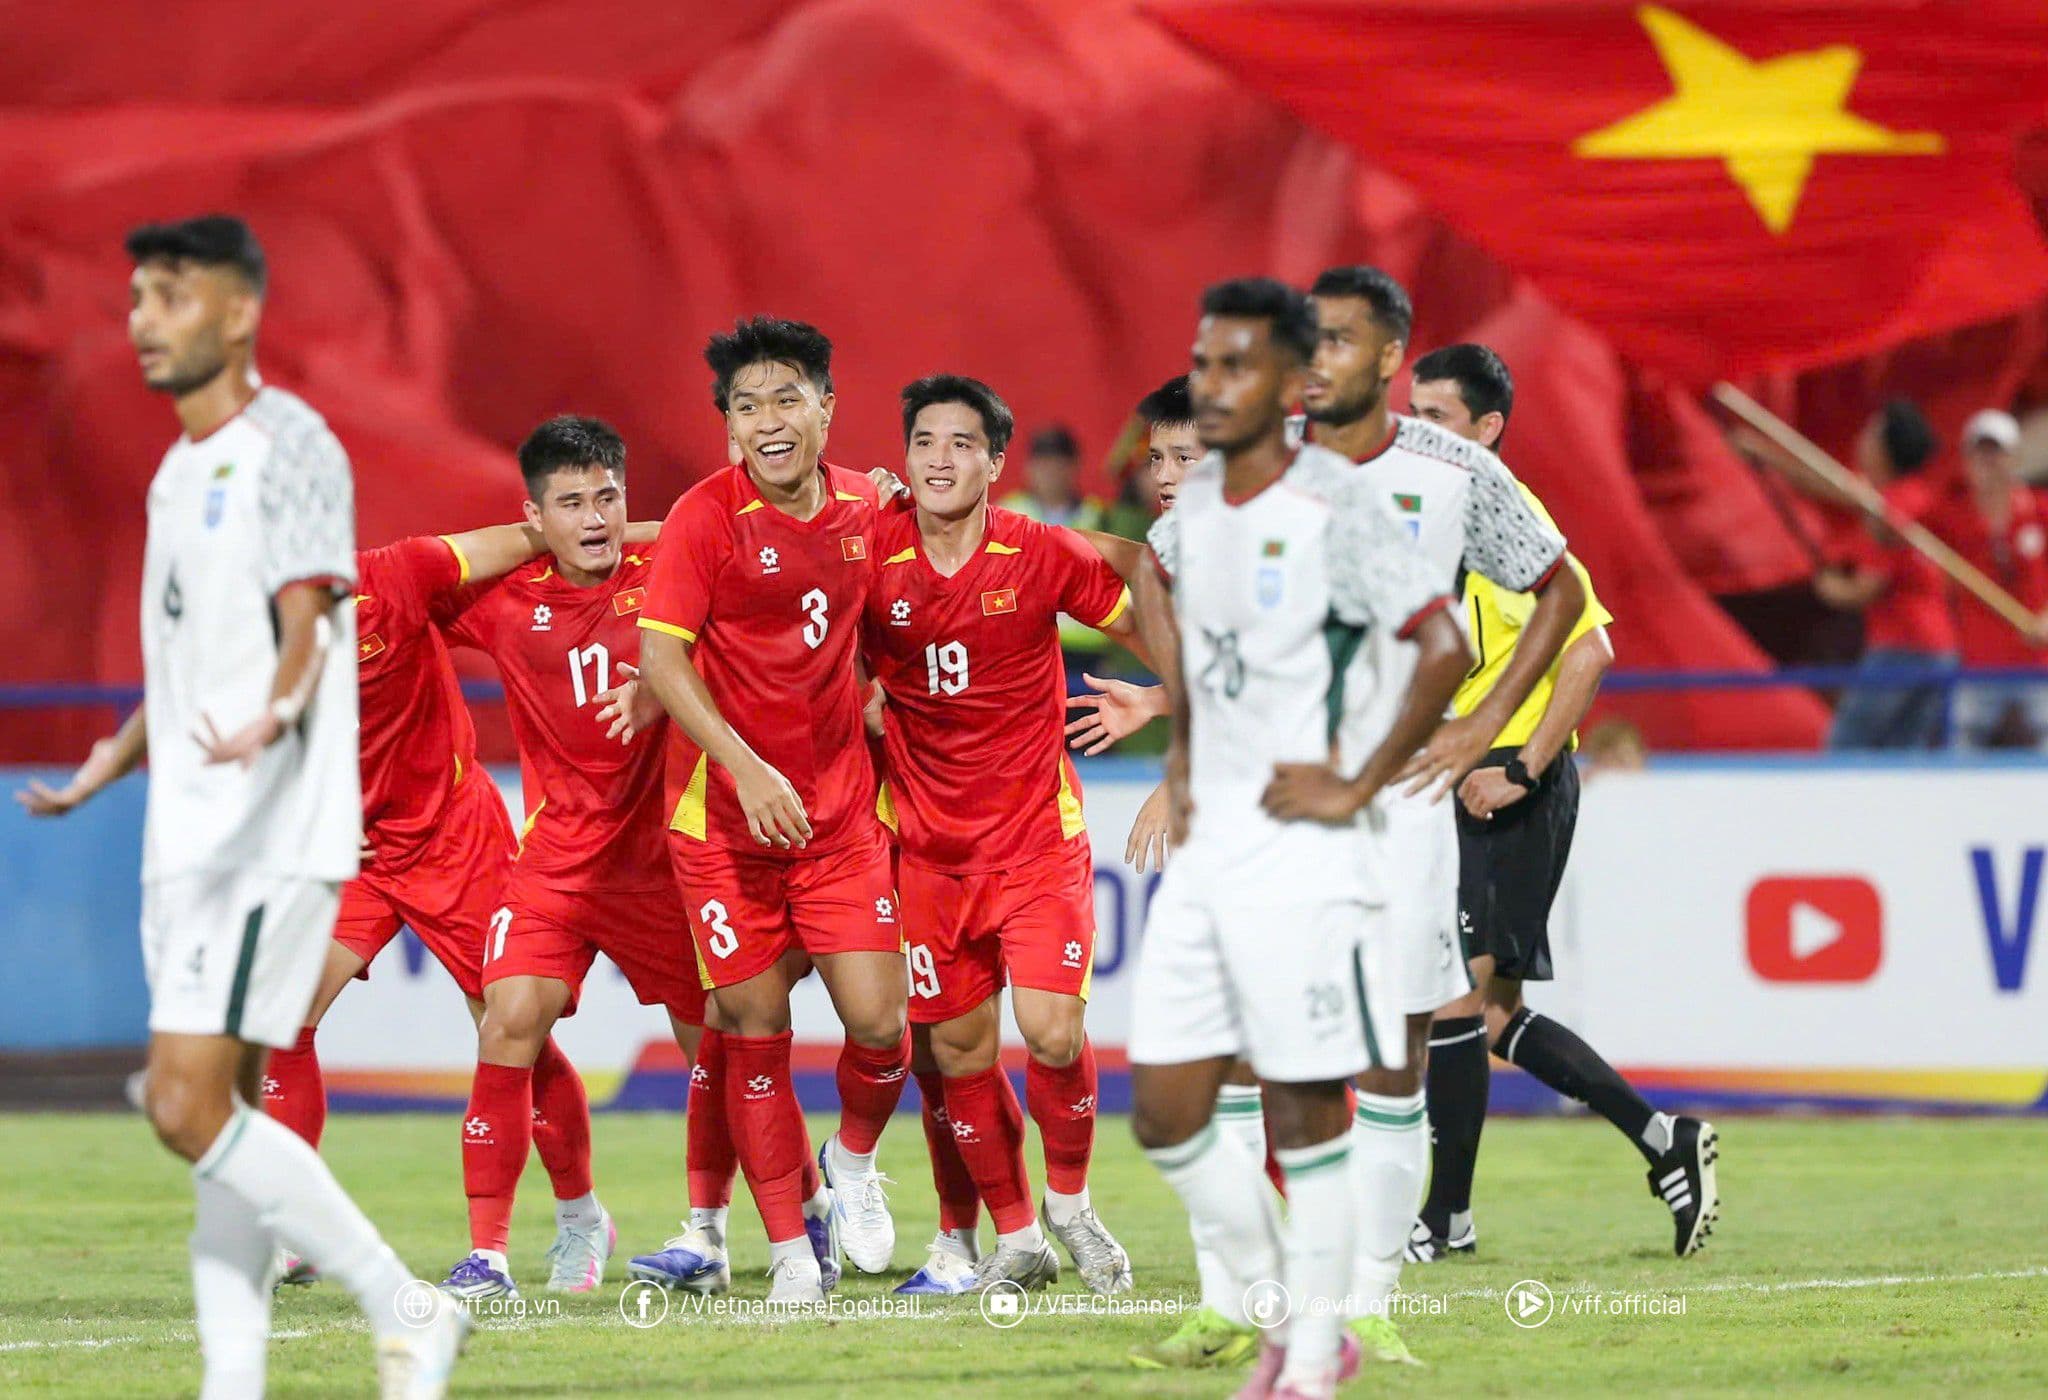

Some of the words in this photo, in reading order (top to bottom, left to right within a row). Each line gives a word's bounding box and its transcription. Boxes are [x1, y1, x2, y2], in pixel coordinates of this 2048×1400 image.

[801, 587, 828, 650] 3
[567, 642, 609, 708] 17
[925, 640, 969, 696] 19
[700, 898, 740, 960] 3
[904, 940, 942, 999] 19
